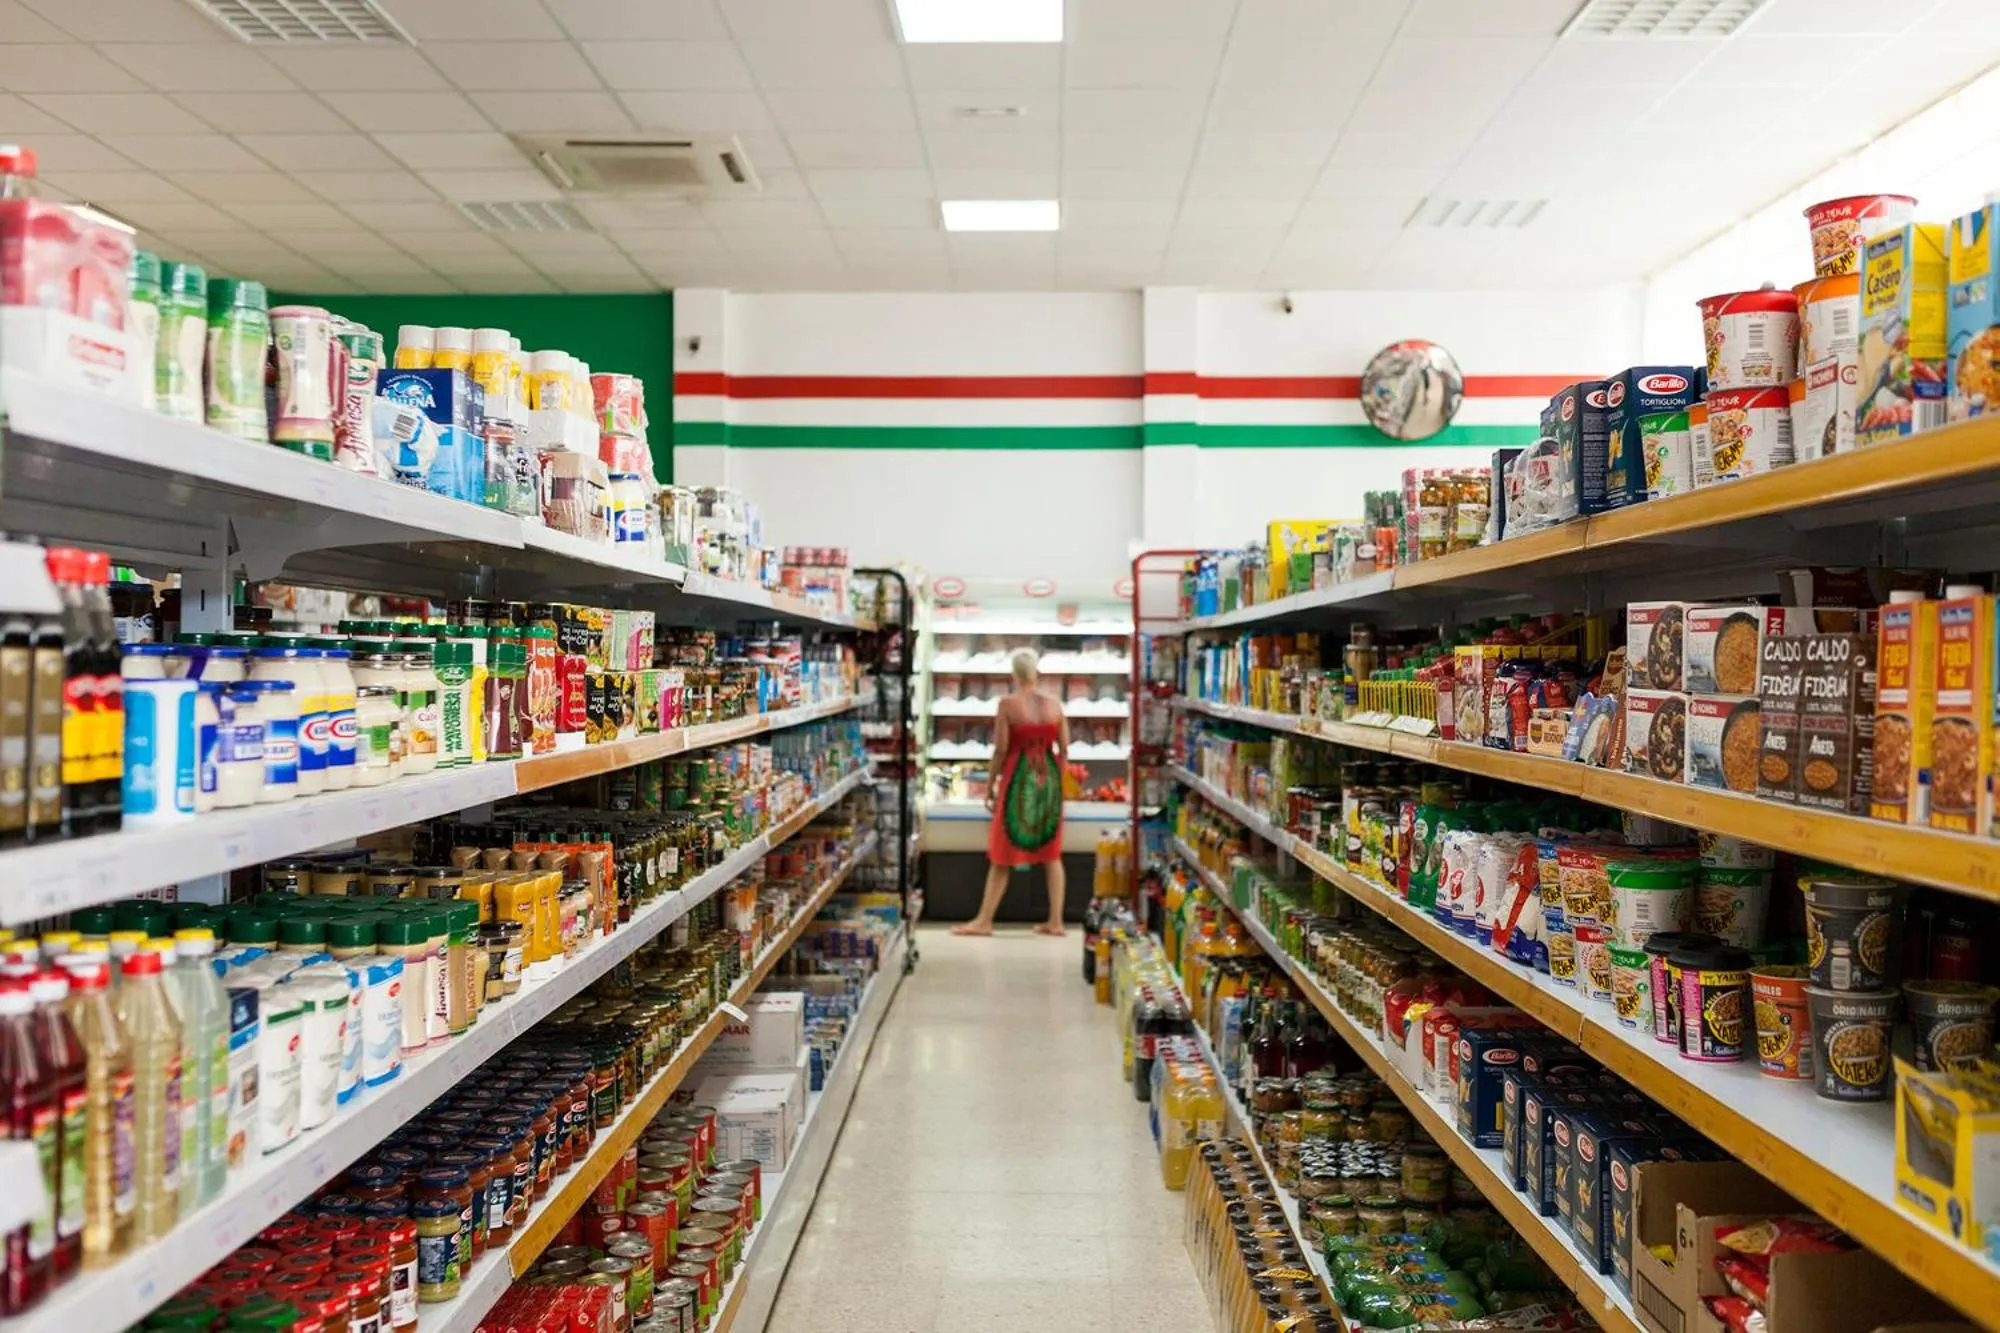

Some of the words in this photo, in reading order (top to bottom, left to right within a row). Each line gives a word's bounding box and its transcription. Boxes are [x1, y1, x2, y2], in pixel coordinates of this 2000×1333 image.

[1649, 379, 1684, 390] Barilla
[1640, 398, 1686, 406] TORTIGLIONI
[1764, 641, 1801, 662] CALDO
[1806, 639, 1849, 662] CALDO
[1760, 666, 1805, 696] FIDEUÁ
[1804, 669, 1849, 698] FIDEUÁ
